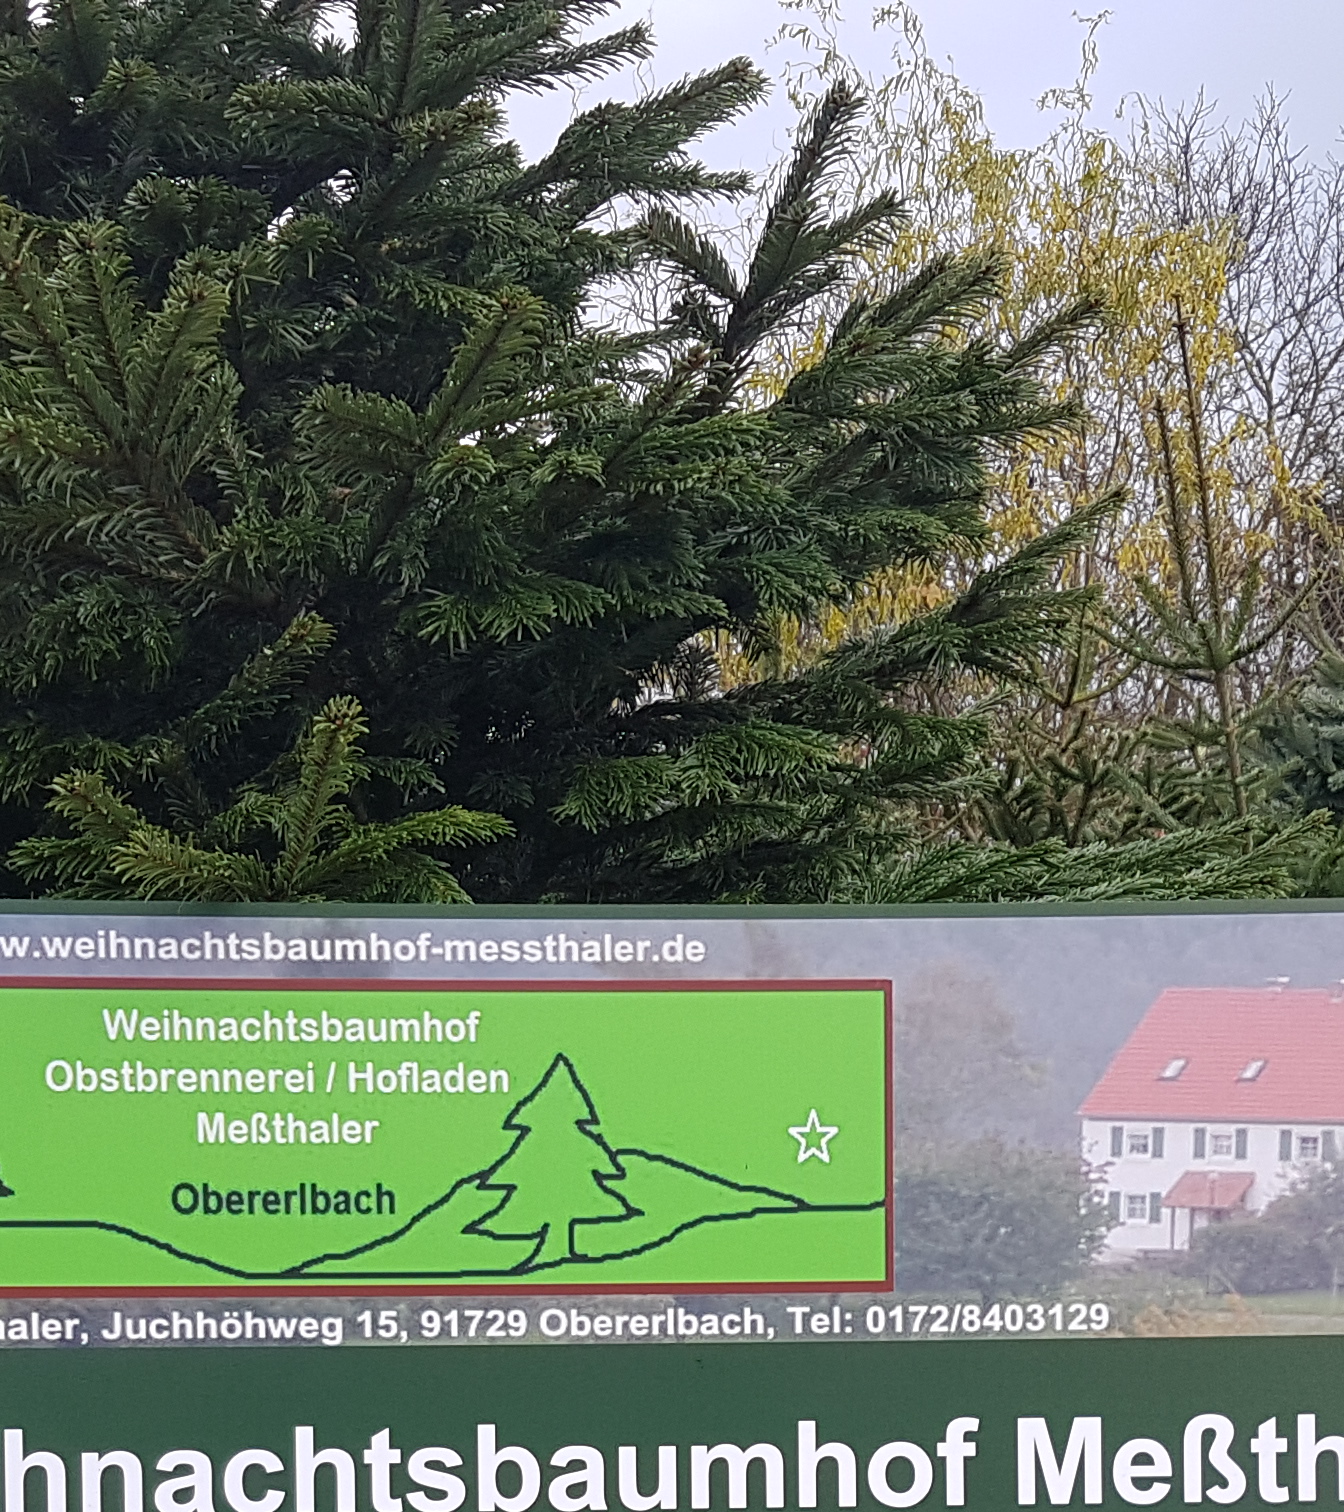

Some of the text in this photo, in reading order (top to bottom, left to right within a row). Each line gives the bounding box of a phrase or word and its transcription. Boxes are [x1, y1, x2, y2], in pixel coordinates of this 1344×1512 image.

[101, 1007, 482, 1044] Weihnachtsbaumhof
[44, 1059, 510, 1094] Obstbrennerei / Hofladen
[196, 1111, 380, 1145] Meßthaler
[170, 1181, 396, 1216] Obererlbach
[100, 1310, 344, 1347] Juchhöhweg
[355, 1309, 409, 1344] 15,
[419, 1308, 529, 1339] 91729
[538, 1306, 776, 1341] Obererlbach,
[785, 1304, 854, 1335] Tel:
[865, 1301, 1111, 1335] 0172/8403129
